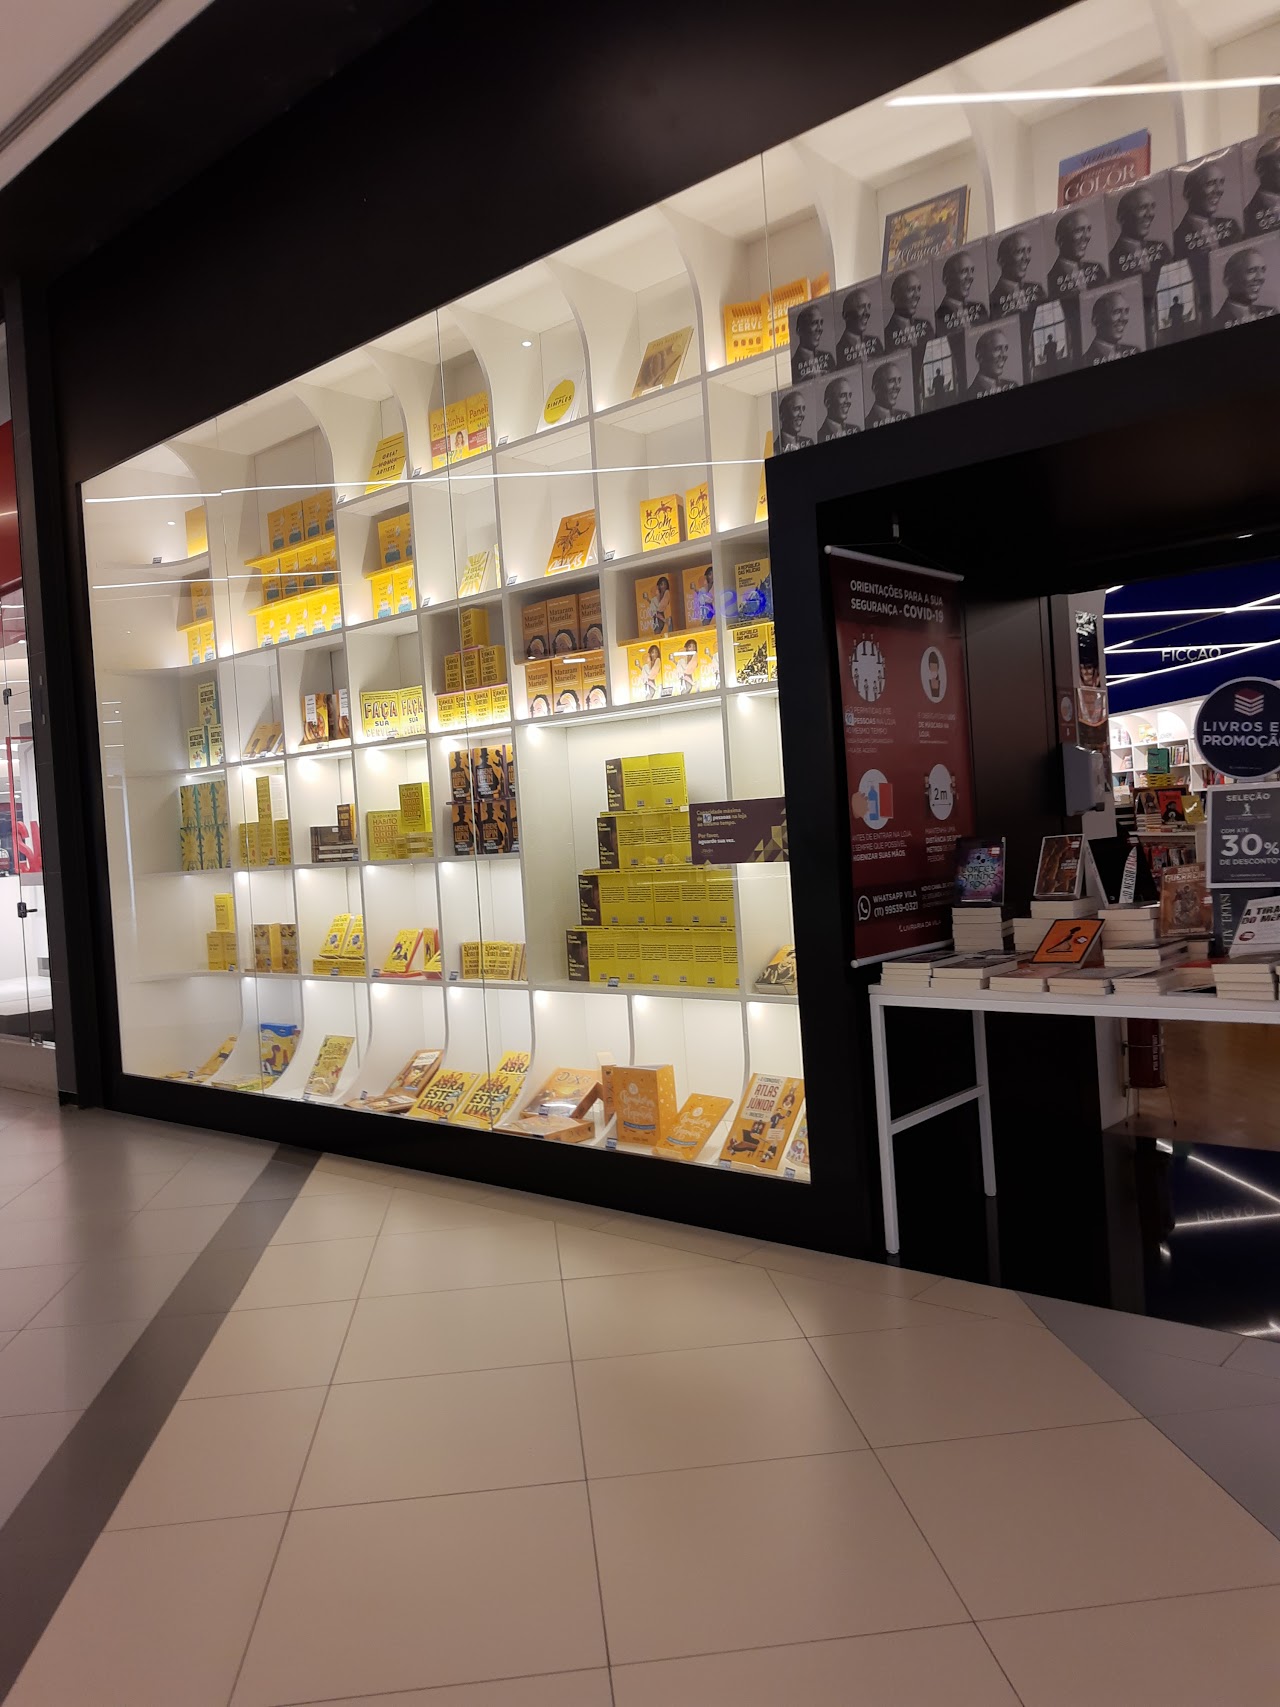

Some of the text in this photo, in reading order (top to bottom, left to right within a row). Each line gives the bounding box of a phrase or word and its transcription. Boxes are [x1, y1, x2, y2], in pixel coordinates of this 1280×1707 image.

[1185, 220, 1232, 242] BARACK
[1187, 231, 1231, 250] OBAMA
[1118, 242, 1164, 265] BARACK
[1121, 253, 1161, 272] OBAMA
[1056, 264, 1099, 285] BARACK
[1060, 274, 1098, 292] OBAMA
[1000, 284, 1039, 304] BARACK
[1002, 294, 1037, 311] OBAMA
[944, 304, 981, 322] BARACK
[946, 313, 980, 329] OBAMA
[892, 321, 928, 339] BARACK
[894, 331, 926, 345] OBAMA
[844, 338, 877, 355] BARACK
[846, 347, 876, 361] OBAMA
[797, 353, 830, 370] BARACK
[800, 361, 829, 376] OBAMA
[547, 395, 572, 410] SIMPLES
[850, 579, 944, 607] ORIENTAÇÕES PARA A SUA
[850, 597, 898, 617] SEGURANÇA
[903, 604, 944, 624] COVID-19
[364, 700, 398, 720] FAÇA
[402, 696, 423, 717] FAÇA
[1203, 721, 1263, 732] LIVROS
[1202, 733, 1280, 749] PROMOÇÃ
[935, 788, 948, 800] 2 m
[1226, 792, 1271, 802] SELEÇÃO
[1220, 833, 1280, 857] 30%
[873, 889, 917, 903] WHATSAPP VILA
[1244, 908, 1252, 916] A
[431, 1079, 465, 1091] ABRA
[477, 1083, 510, 1095] ABRA
[754, 1084, 779, 1098] ATLAS
[425, 1089, 450, 1100] ESTE
[417, 1100, 454, 1112] LIVRO
[746, 1096, 775, 1111] JÚNIOR
